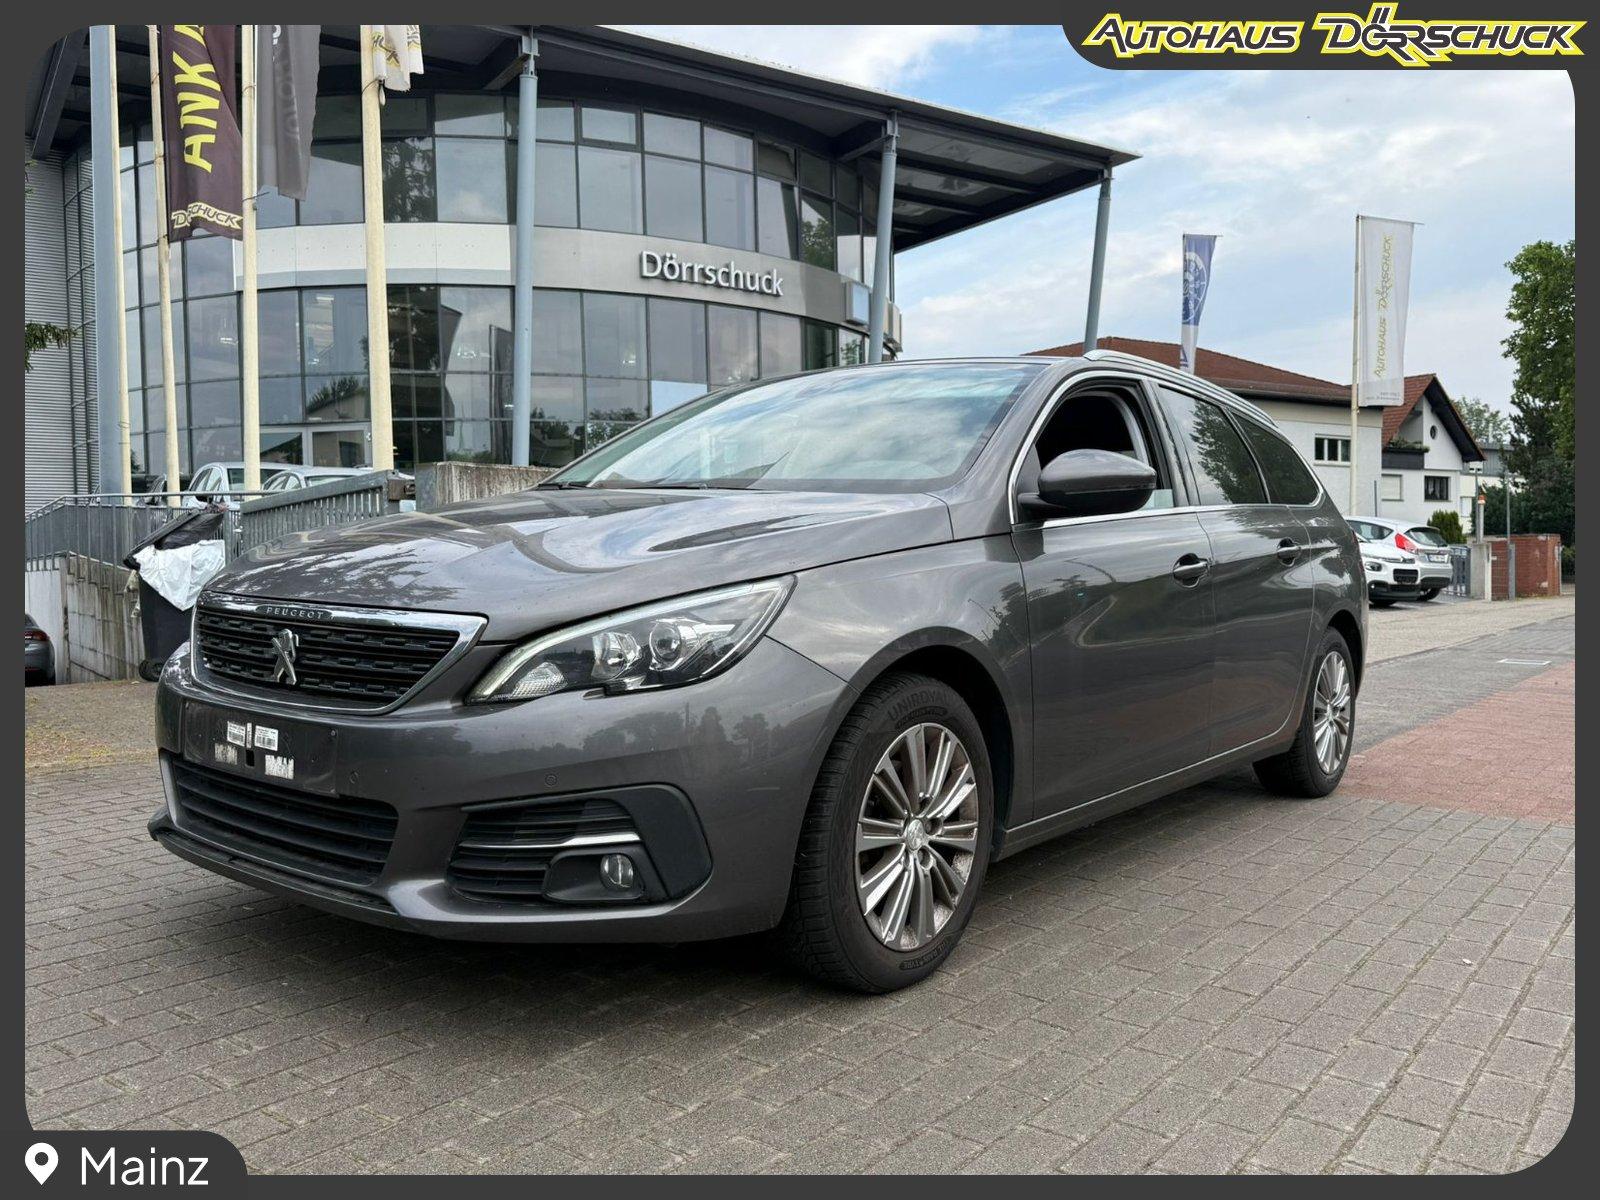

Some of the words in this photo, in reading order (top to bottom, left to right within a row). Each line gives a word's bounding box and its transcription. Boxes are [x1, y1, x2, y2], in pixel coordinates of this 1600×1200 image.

[641, 250, 784, 296] Dörrschuck
[1373, 315, 1388, 378] AUTOHAUS
[266, 606, 324, 620] PEUGEOT
